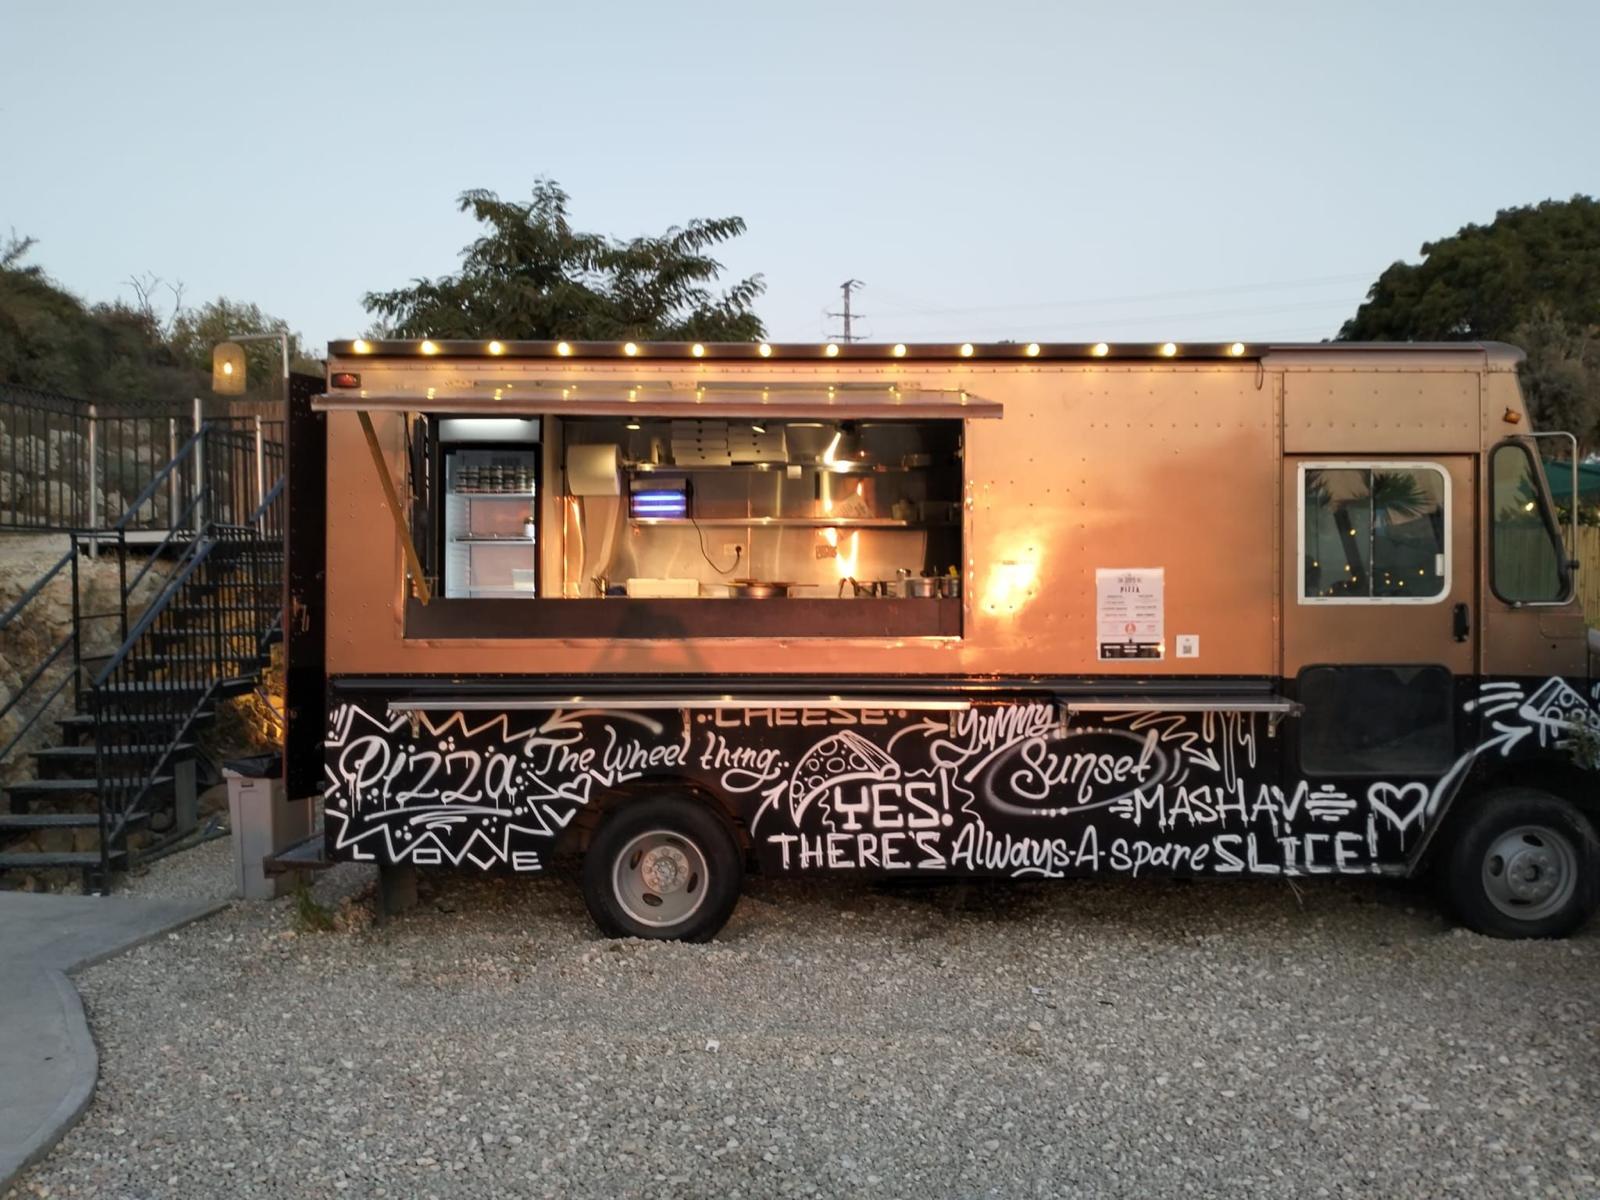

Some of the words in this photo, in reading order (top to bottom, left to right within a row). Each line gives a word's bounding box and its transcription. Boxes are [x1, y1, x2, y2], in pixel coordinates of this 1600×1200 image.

[524, 731, 596, 776] The
[604, 724, 688, 772] Wheel
[1010, 728, 1160, 804] Sunset
[833, 779, 954, 830] YES!
[1133, 778, 1309, 834] MASHAV
[767, 831, 947, 870] THERE'S
